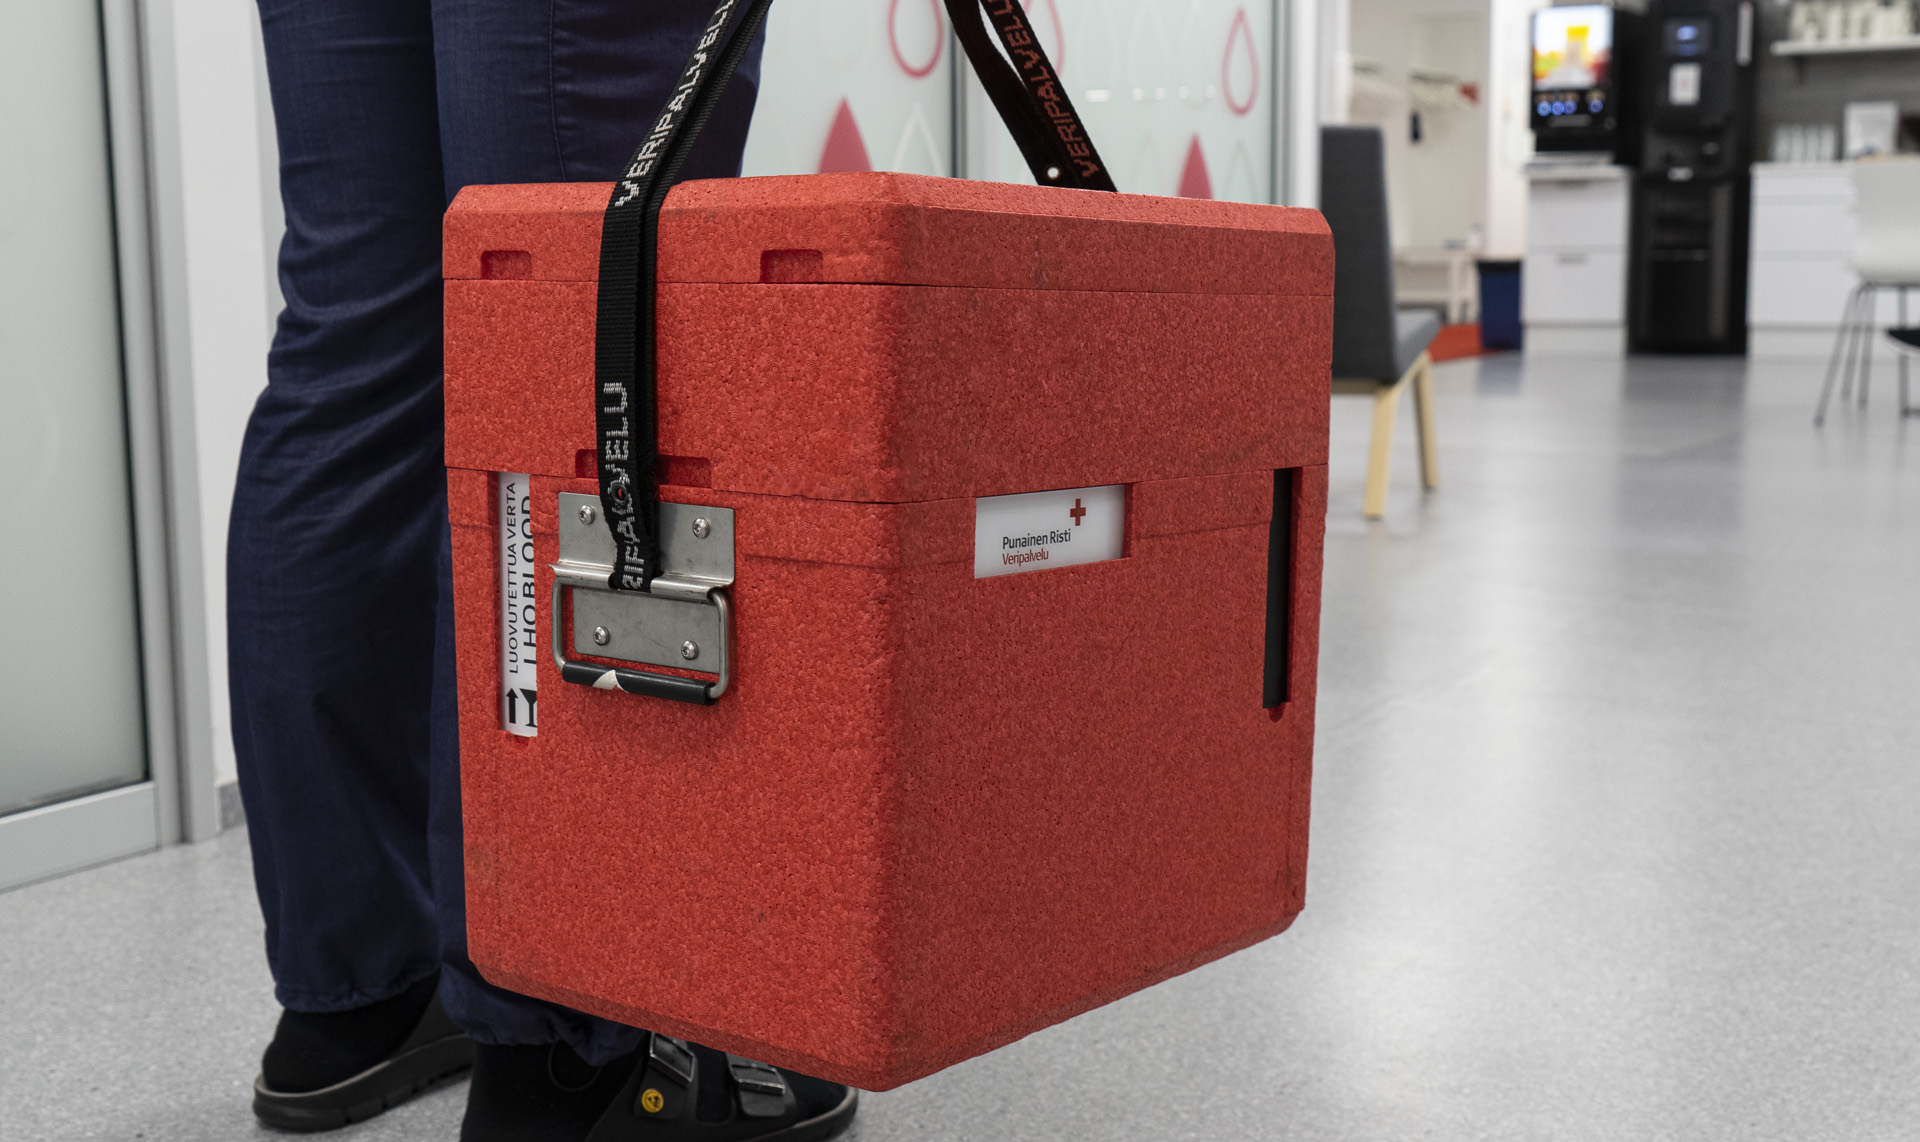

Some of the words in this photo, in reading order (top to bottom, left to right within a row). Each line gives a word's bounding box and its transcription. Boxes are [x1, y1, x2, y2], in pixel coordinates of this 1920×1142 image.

[506, 482, 516, 540] VERTA
[1002, 533, 1048, 550] Punainen
[1050, 528, 1072, 544] Risti
[1002, 548, 1049, 566] Veripalvelu
[507, 543, 519, 674] LUOVUTETTUA
